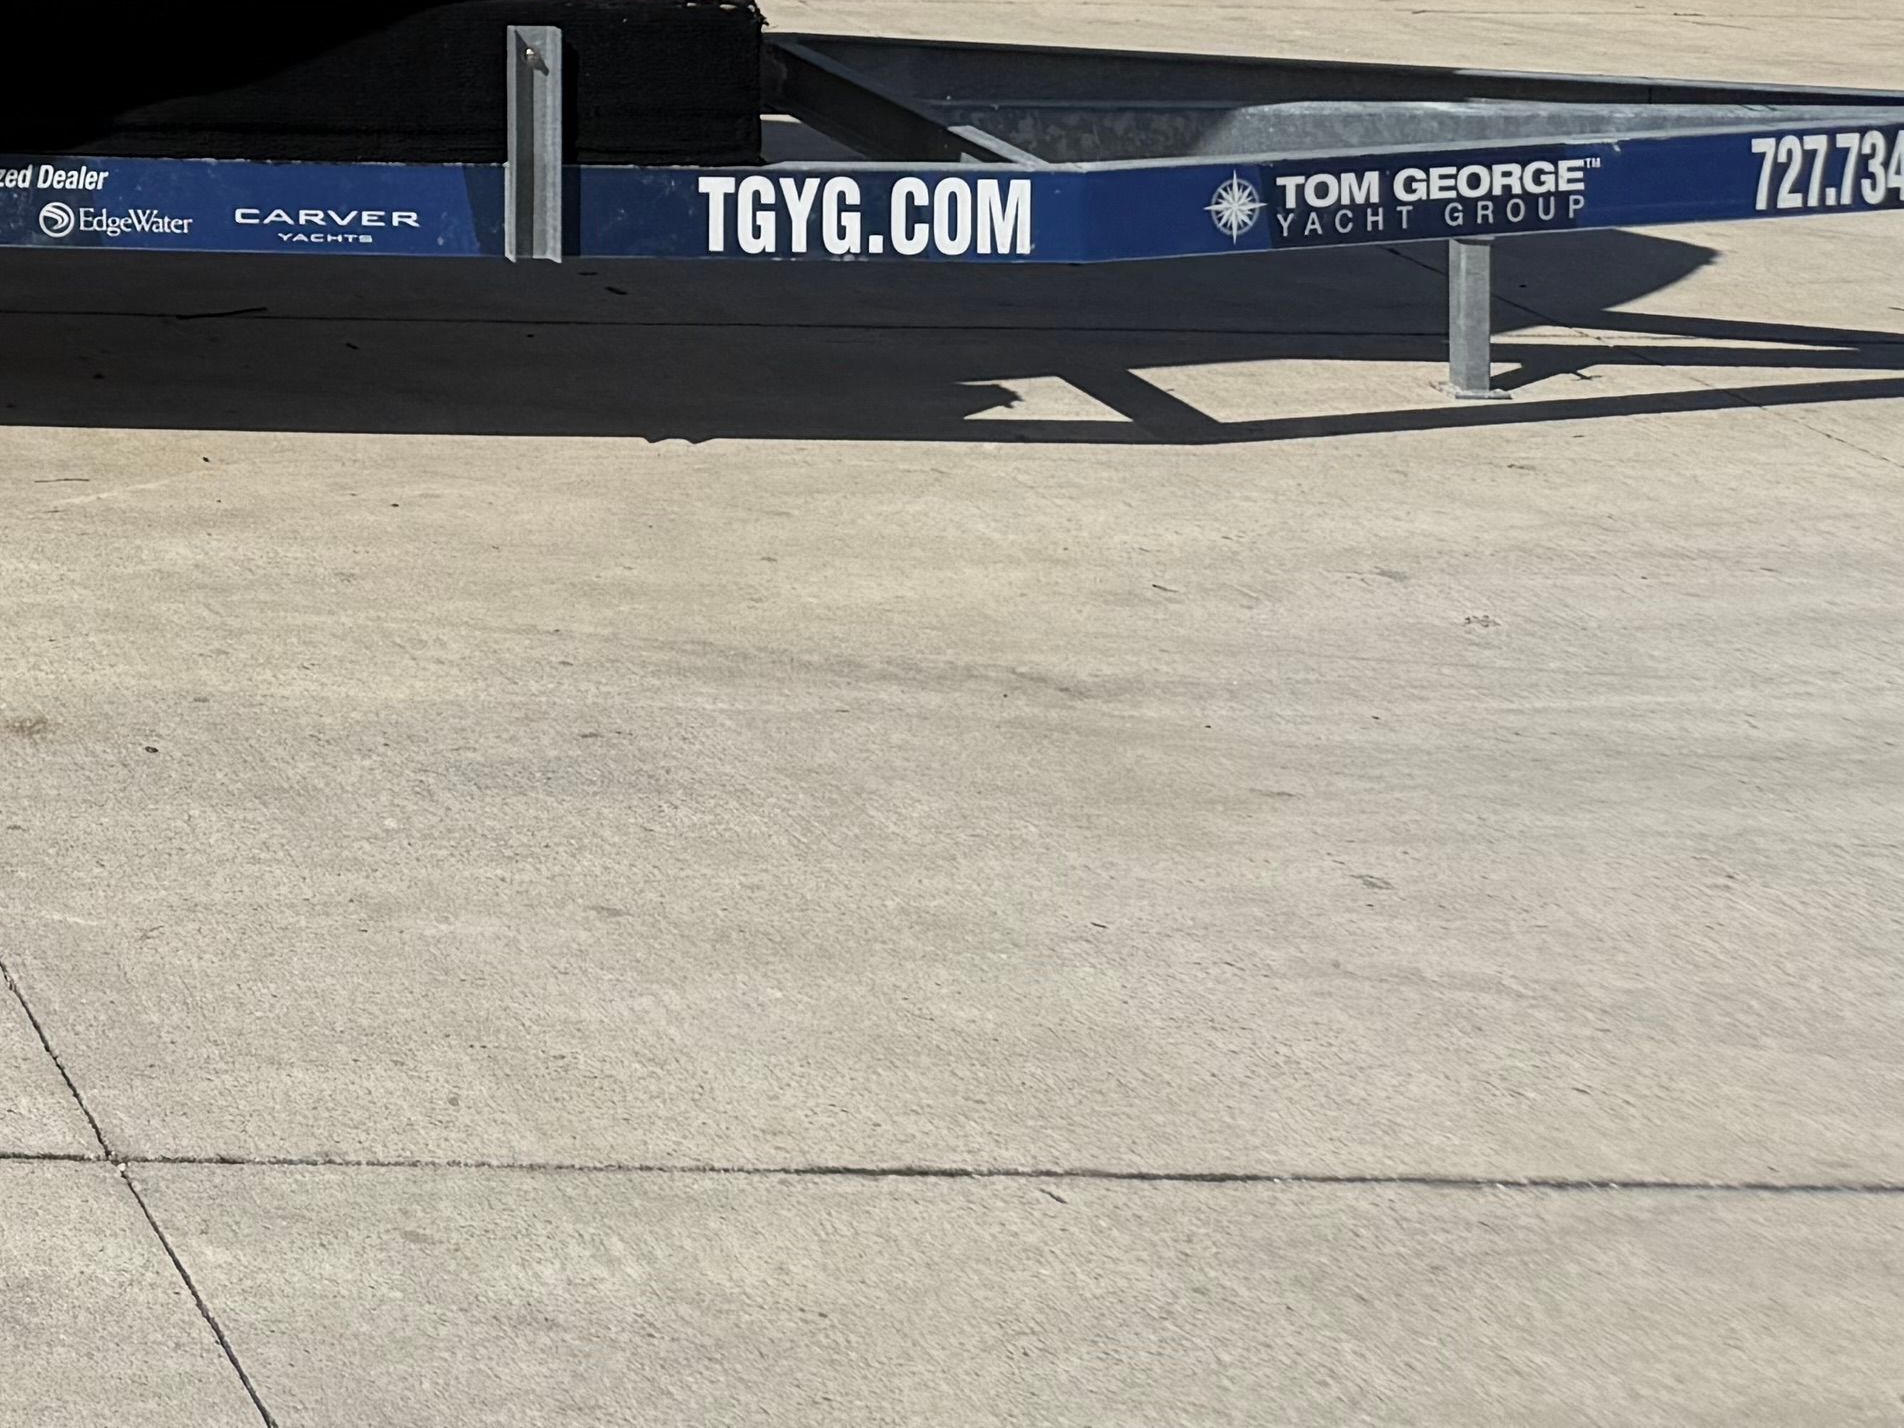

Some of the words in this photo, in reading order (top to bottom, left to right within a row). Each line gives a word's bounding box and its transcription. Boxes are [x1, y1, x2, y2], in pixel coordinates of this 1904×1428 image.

[37, 164, 109, 190] Dealer
[1276, 171, 1380, 209] TOM
[79, 207, 193, 236] EdgeWater
[235, 208, 421, 228] CARVER
[698, 175, 1032, 256] TGYG.COM
[1277, 205, 1413, 237] YACHT
[1444, 195, 1585, 227] GROUP
[277, 232, 373, 243] YACHTS
